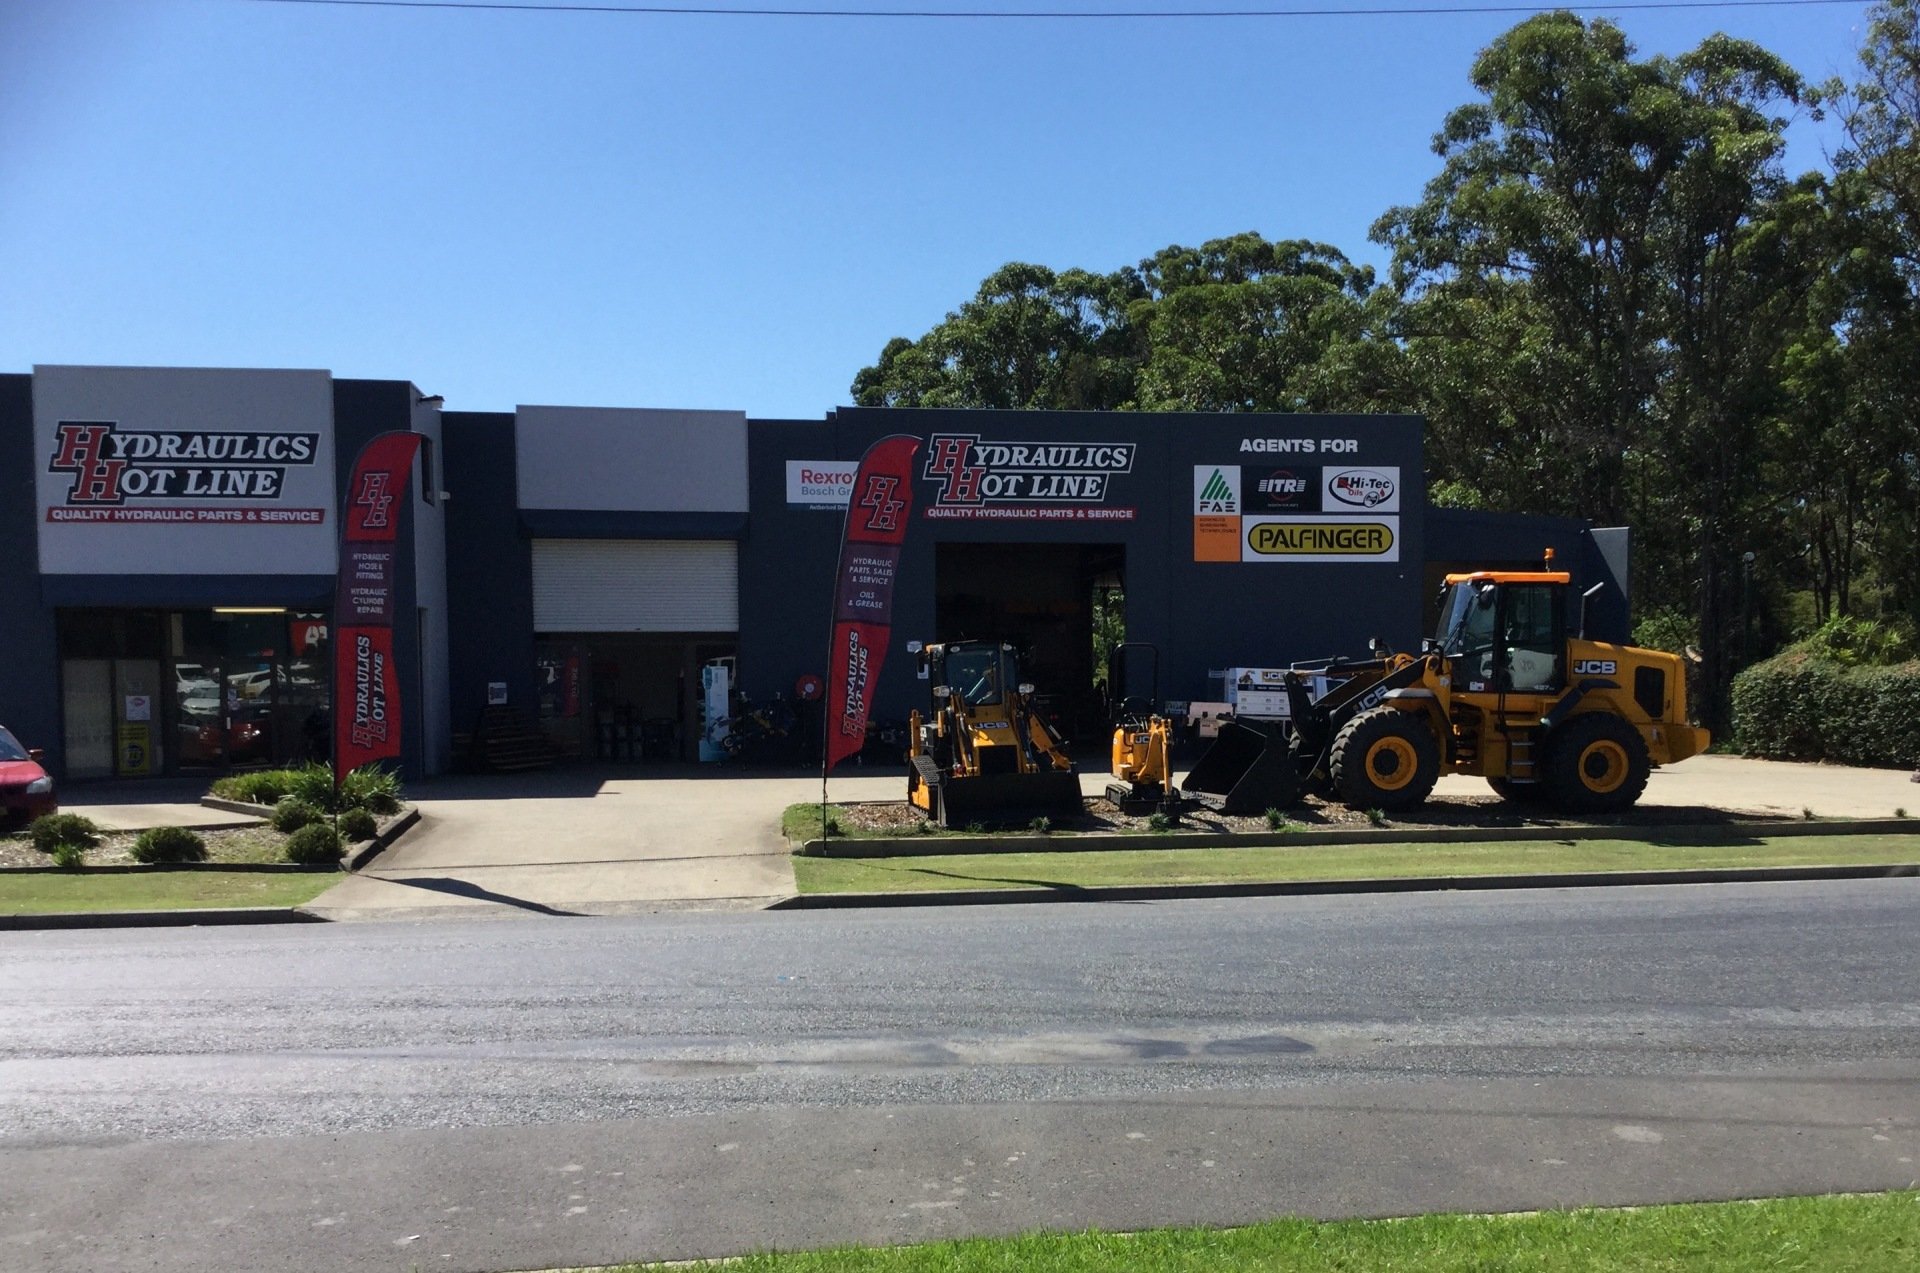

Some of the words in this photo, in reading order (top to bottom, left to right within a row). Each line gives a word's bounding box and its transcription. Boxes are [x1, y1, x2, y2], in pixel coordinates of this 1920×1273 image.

[54, 426, 311, 467] HYDRAULICS
[1239, 438, 1316, 453] AGENTS
[1320, 439, 1359, 453] FOR
[930, 439, 1128, 474] HYDRAULICS
[71, 460, 177, 501] HOT
[183, 470, 280, 496] LINE
[801, 469, 853, 485] Rexro
[1349, 477, 1391, 489] Hi-Tec
[801, 486, 835, 496] Bosch
[945, 467, 1025, 502] HOT
[1029, 475, 1103, 497] LINE
[927, 508, 973, 518] QUALITY
[975, 508, 1037, 518] HYDRAULIC
[1039, 509, 1075, 518] PARTS
[1077, 509, 1086, 518] &
[1088, 509, 1133, 519] SERVICE
[1199, 501, 1236, 513] FAE
[51, 510, 111, 520] QUALITY
[114, 510, 195, 521] HYDRAULIC
[197, 511, 243, 521] PARTS
[246, 511, 257, 521] &
[260, 511, 320, 522] SERVICE
[1259, 528, 1384, 549] PALFINGER
[853, 556, 893, 568] HYDRAULIC
[873, 567, 893, 577] SALES
[859, 575, 889, 585] SERVICE
[859, 591, 875, 600] OILS
[855, 600, 884, 609] GREASE
[373, 652, 385, 695] LINE
[858, 647, 869, 688] LINE
[1573, 660, 1617, 674] JCB
[352, 636, 372, 748] HYDRAULICS
[1355, 685, 1389, 713] JCB
[974, 721, 1009, 729] JCB
[1135, 735, 1150, 744] JC
